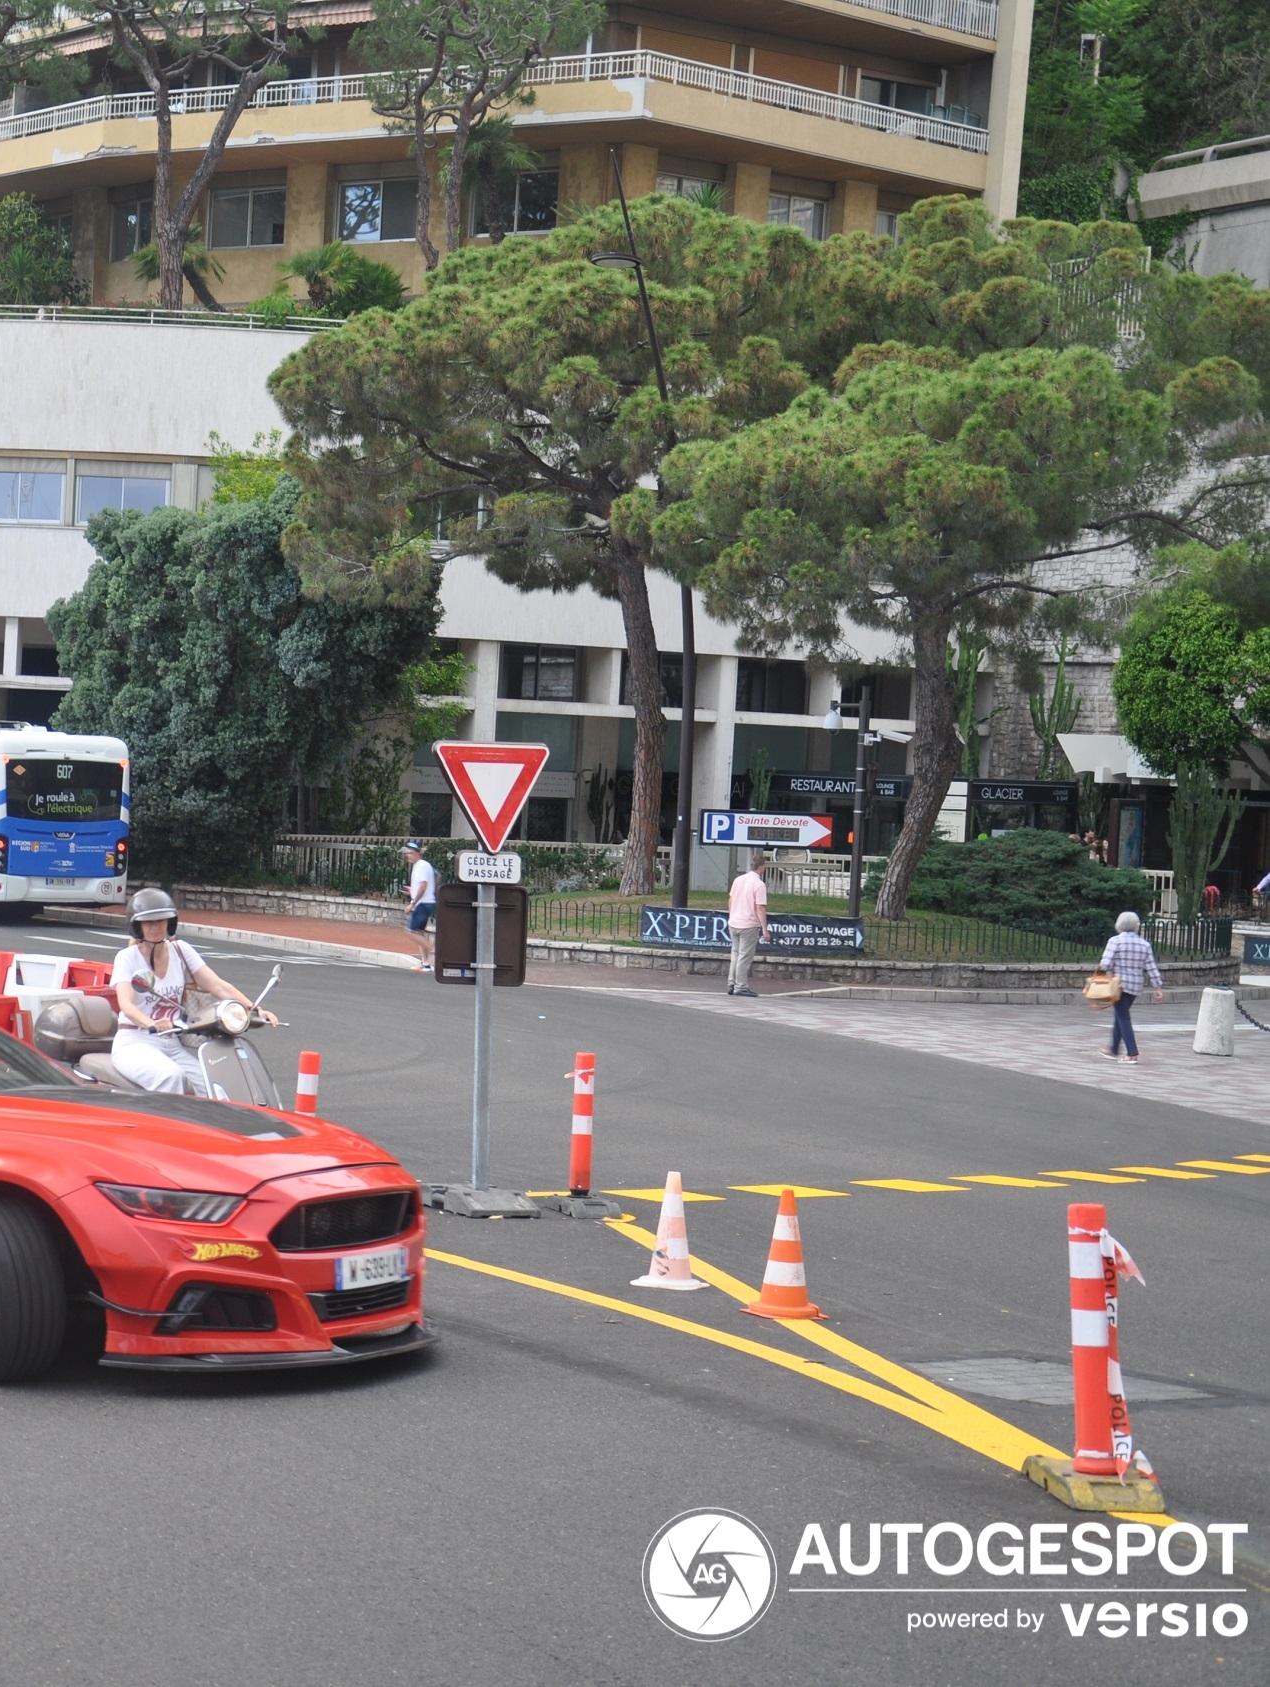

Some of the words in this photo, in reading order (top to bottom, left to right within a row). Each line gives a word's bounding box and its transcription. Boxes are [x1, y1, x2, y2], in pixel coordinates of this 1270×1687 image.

[56, 764, 73, 779] 607
[790, 779, 857, 793] RESTAURANT
[35, 794, 44, 806] Je
[46, 791, 69, 802] roule
[69, 792, 76, 802] à
[981, 787, 1024, 800] GLACIER
[46, 802, 93, 815] l'électrique
[737, 816, 770, 826] Sainte
[772, 816, 809, 827] Dévote
[467, 855, 498, 867] CÉDEZ
[502, 858, 514, 867] LE
[468, 869, 512, 879] PASSAGE
[643, 910, 732, 942] X'PER
[766, 923, 797, 933] ATION
[799, 924, 813, 933] DE
[815, 926, 855, 937] LAVAGE
[778, 937, 802, 946] +377
[803, 937, 815, 946] 93
[817, 937, 828, 946] 25
[191, 1242, 220, 1260] HOT
[217, 1242, 260, 1259] WHEELS
[1104, 1256, 1116, 1326] POLICE
[1110, 1393, 1129, 1462] POLICE
